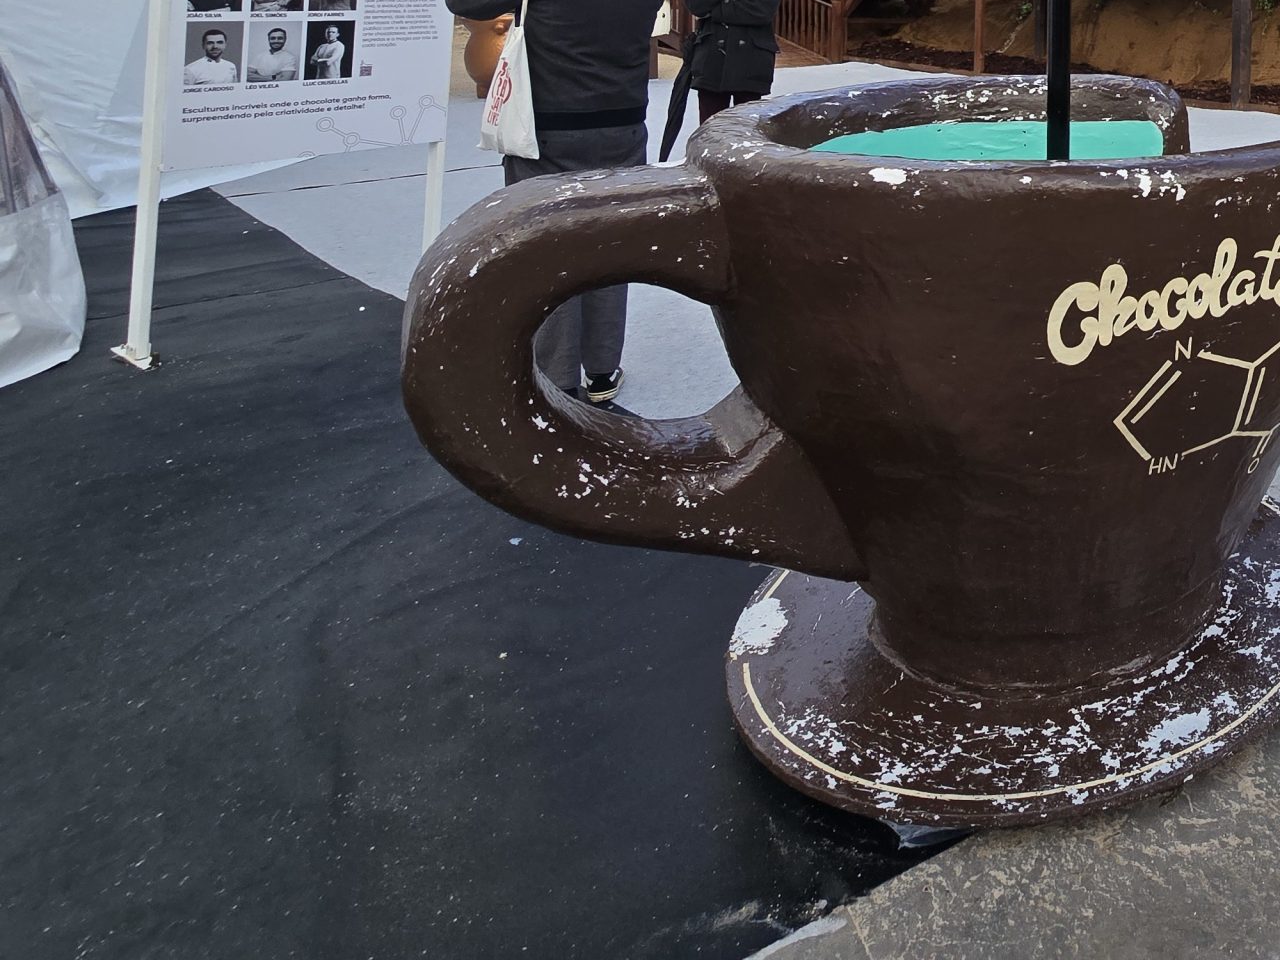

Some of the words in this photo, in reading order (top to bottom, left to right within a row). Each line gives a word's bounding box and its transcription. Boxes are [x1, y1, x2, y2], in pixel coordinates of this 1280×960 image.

[182, 106, 230, 114] Esculturas
[231, 102, 267, 110] incríveis
[300, 97, 340, 106] chocolate
[341, 95, 366, 103] ganha
[368, 93, 391, 101] forma,
[182, 113, 252, 123] surpreendendo
[253, 109, 273, 118] pela
[275, 105, 324, 116] criatividade
[333, 103, 365, 111] detalhe!
[1174, 336, 1193, 361] N
[1148, 453, 1178, 475] HN
